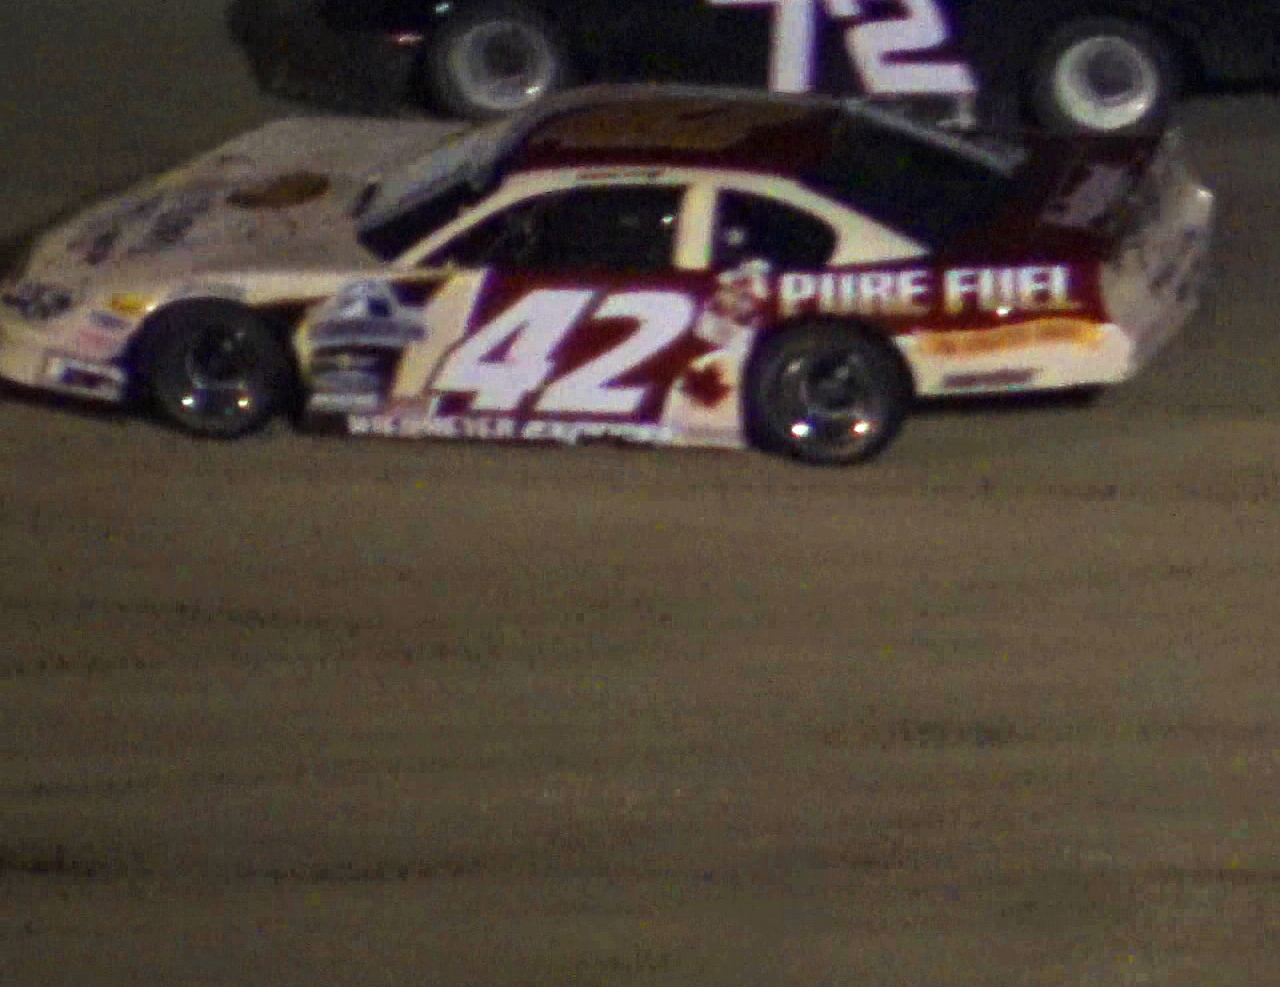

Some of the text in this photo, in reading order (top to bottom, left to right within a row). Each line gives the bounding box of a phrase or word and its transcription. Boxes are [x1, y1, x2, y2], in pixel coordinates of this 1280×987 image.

[778, 263, 1072, 316] PURE FUEL
[432, 288, 700, 415] 42
